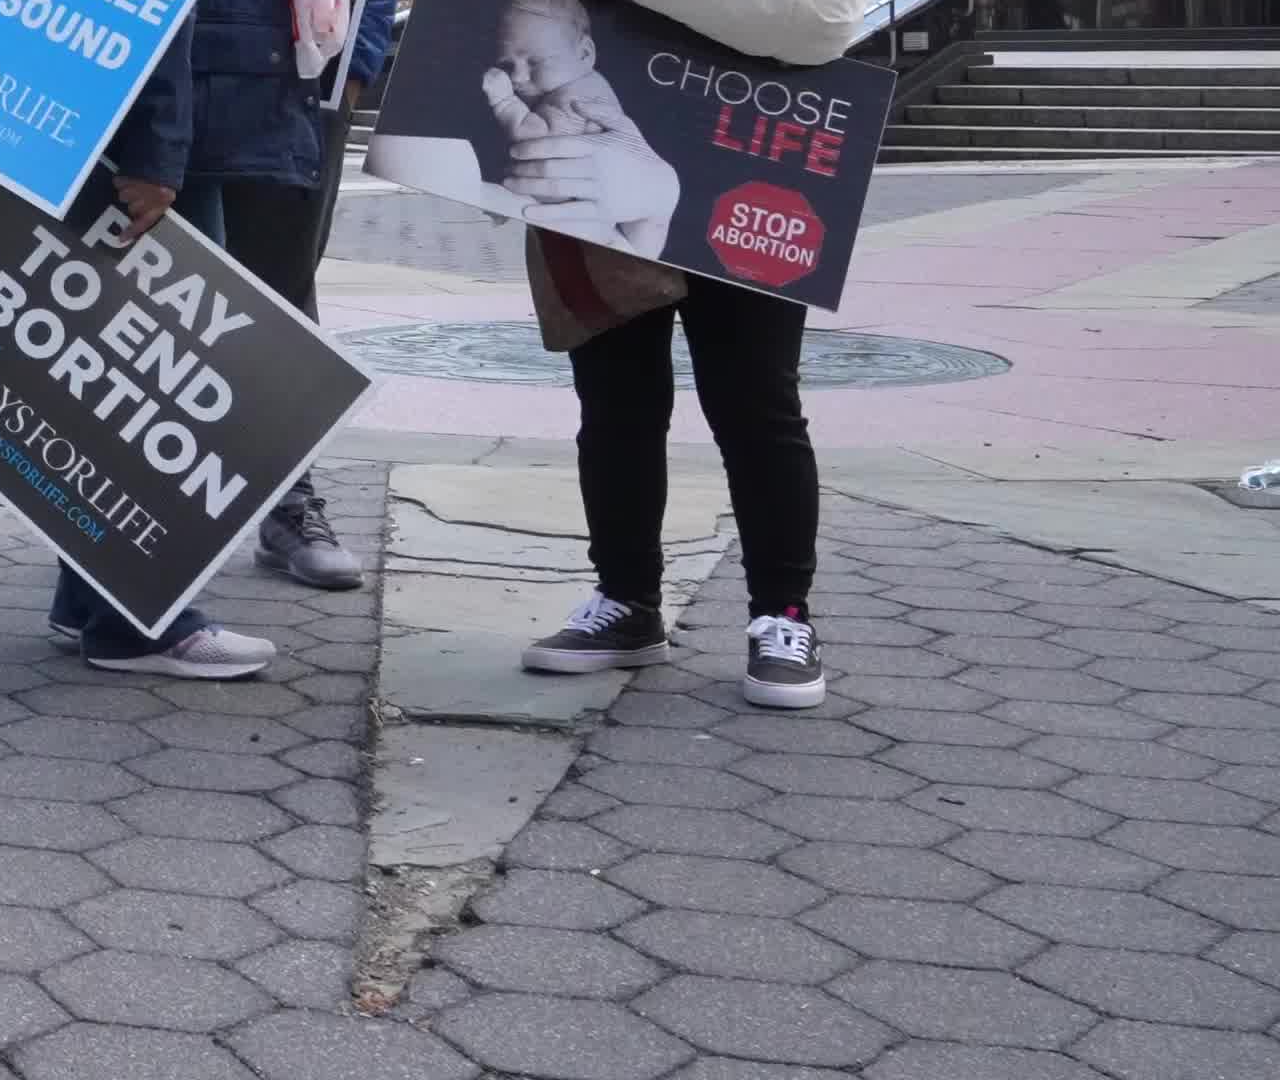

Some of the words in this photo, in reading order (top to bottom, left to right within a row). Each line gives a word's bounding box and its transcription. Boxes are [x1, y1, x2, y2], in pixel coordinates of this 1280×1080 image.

[10, 85, 82, 146] LIFE
[647, 51, 852, 134] CHOOSE
[711, 105, 845, 177] LIFE
[711, 223, 816, 268] ABORTION
[730, 202, 807, 241] STOP
[80, 204, 256, 349] PRAY
[17, 225, 103, 312] TO
[97, 300, 234, 423] END
[23, 419, 97, 499] FOR
[87, 476, 169, 556] LIFE
